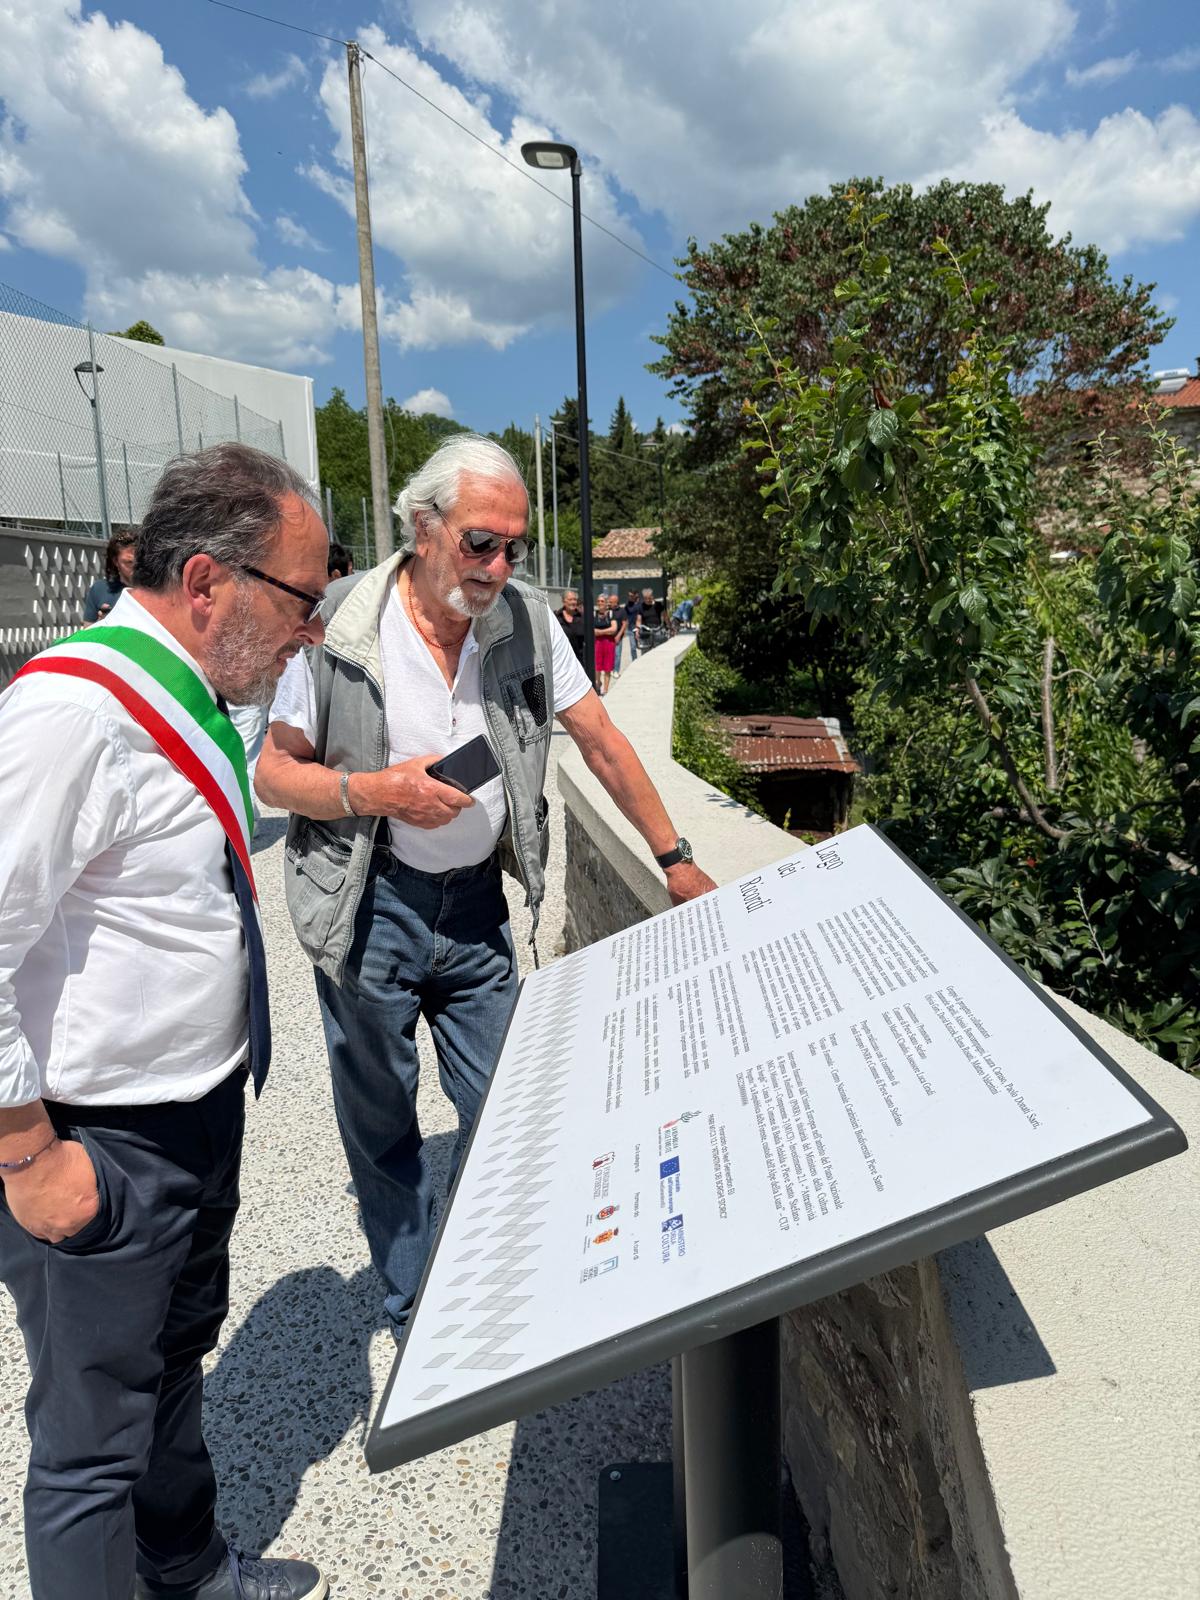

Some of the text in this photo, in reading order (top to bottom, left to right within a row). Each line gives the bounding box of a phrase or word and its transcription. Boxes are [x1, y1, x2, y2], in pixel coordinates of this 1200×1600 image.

[778, 861, 806, 878] dei
[816, 842, 843, 870] Largo
[740, 875, 772, 913] Ricordi
